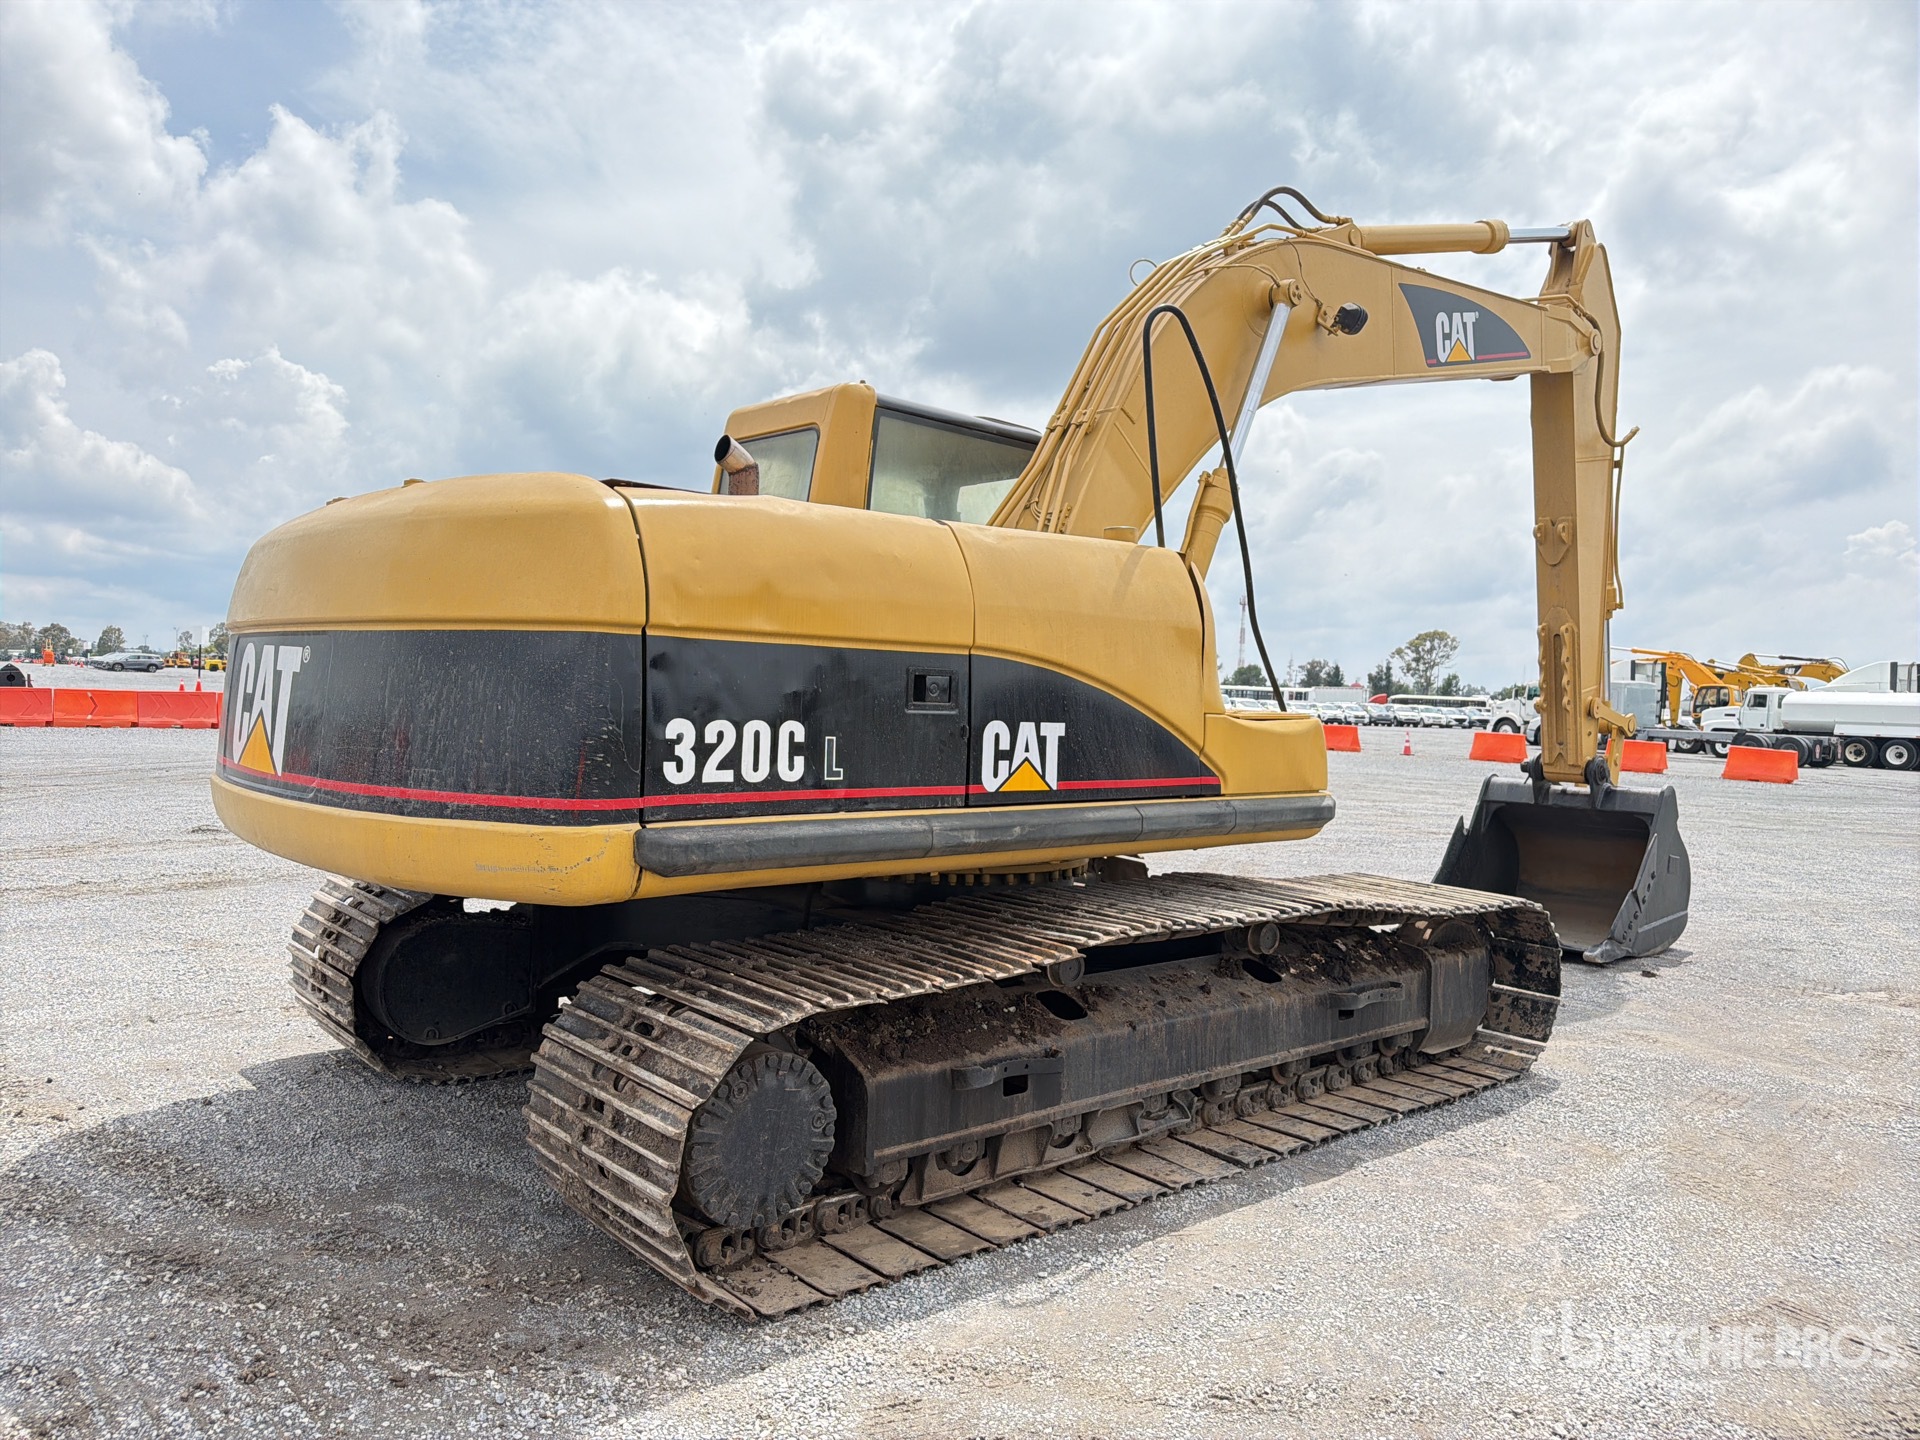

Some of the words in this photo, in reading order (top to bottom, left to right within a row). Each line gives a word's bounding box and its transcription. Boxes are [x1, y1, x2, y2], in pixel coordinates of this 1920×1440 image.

[1435, 311, 1477, 363] CAT
[232, 642, 304, 777] CAT
[662, 717, 805, 785] 320C
[823, 736, 844, 781] L
[981, 719, 1066, 793] CAT
